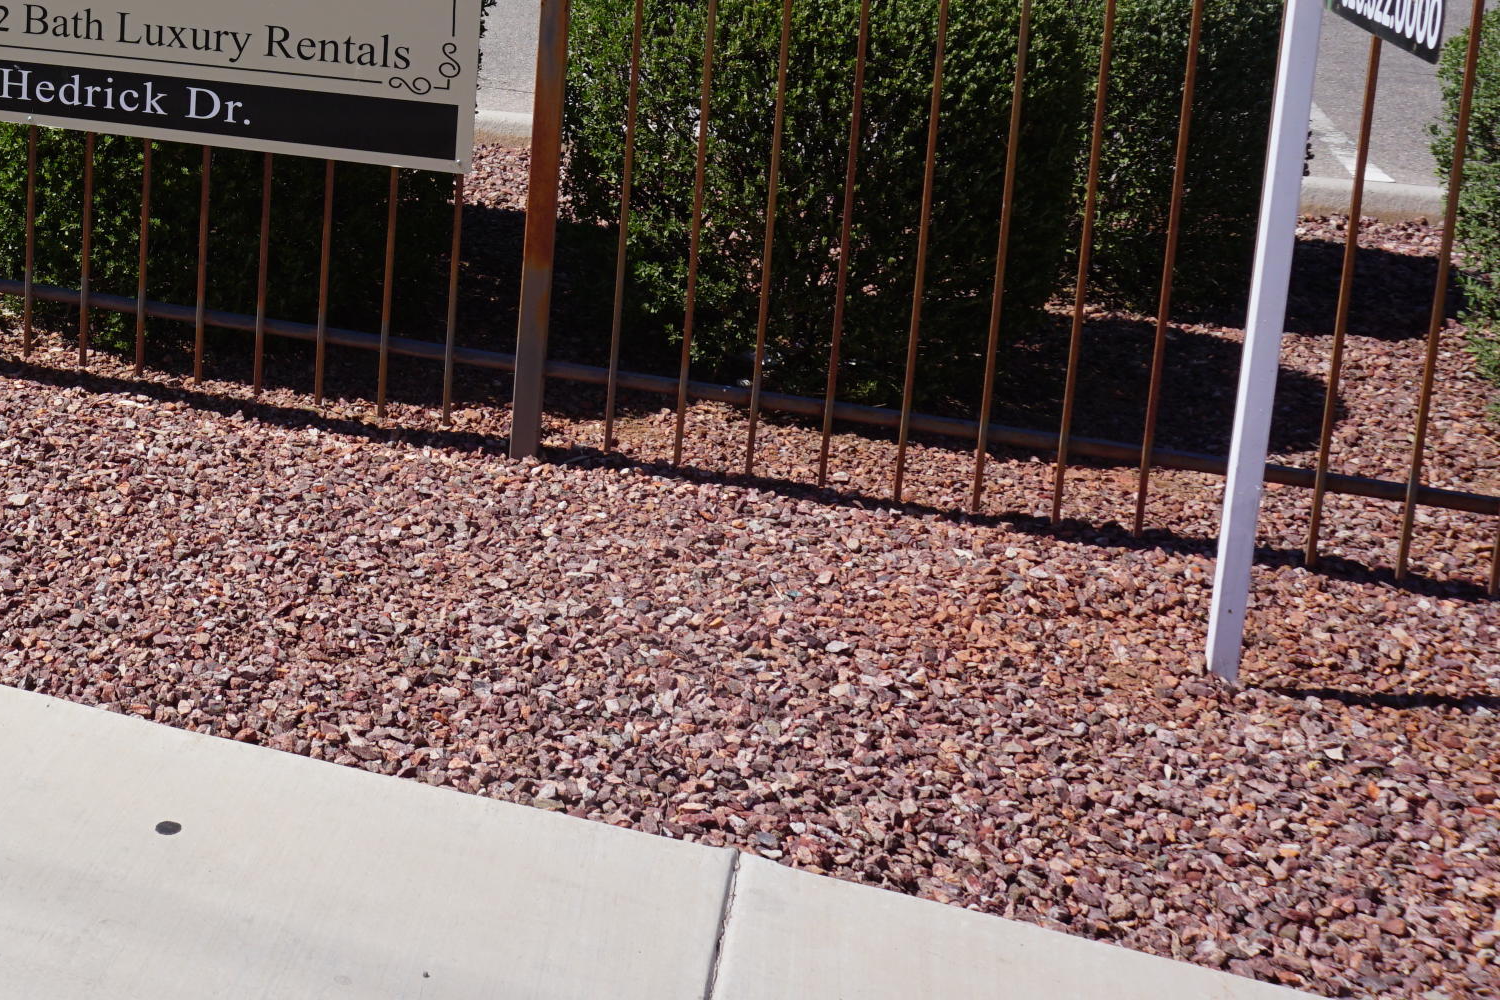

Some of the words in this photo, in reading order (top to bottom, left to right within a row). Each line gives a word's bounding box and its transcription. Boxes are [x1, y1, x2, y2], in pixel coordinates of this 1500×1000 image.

[23, 4, 104, 41] Bath
[116, 12, 252, 62] Luxury
[263, 25, 411, 70] Rentals
[0, 67, 168, 116] Hedrick
[184, 87, 251, 126] Dr.
